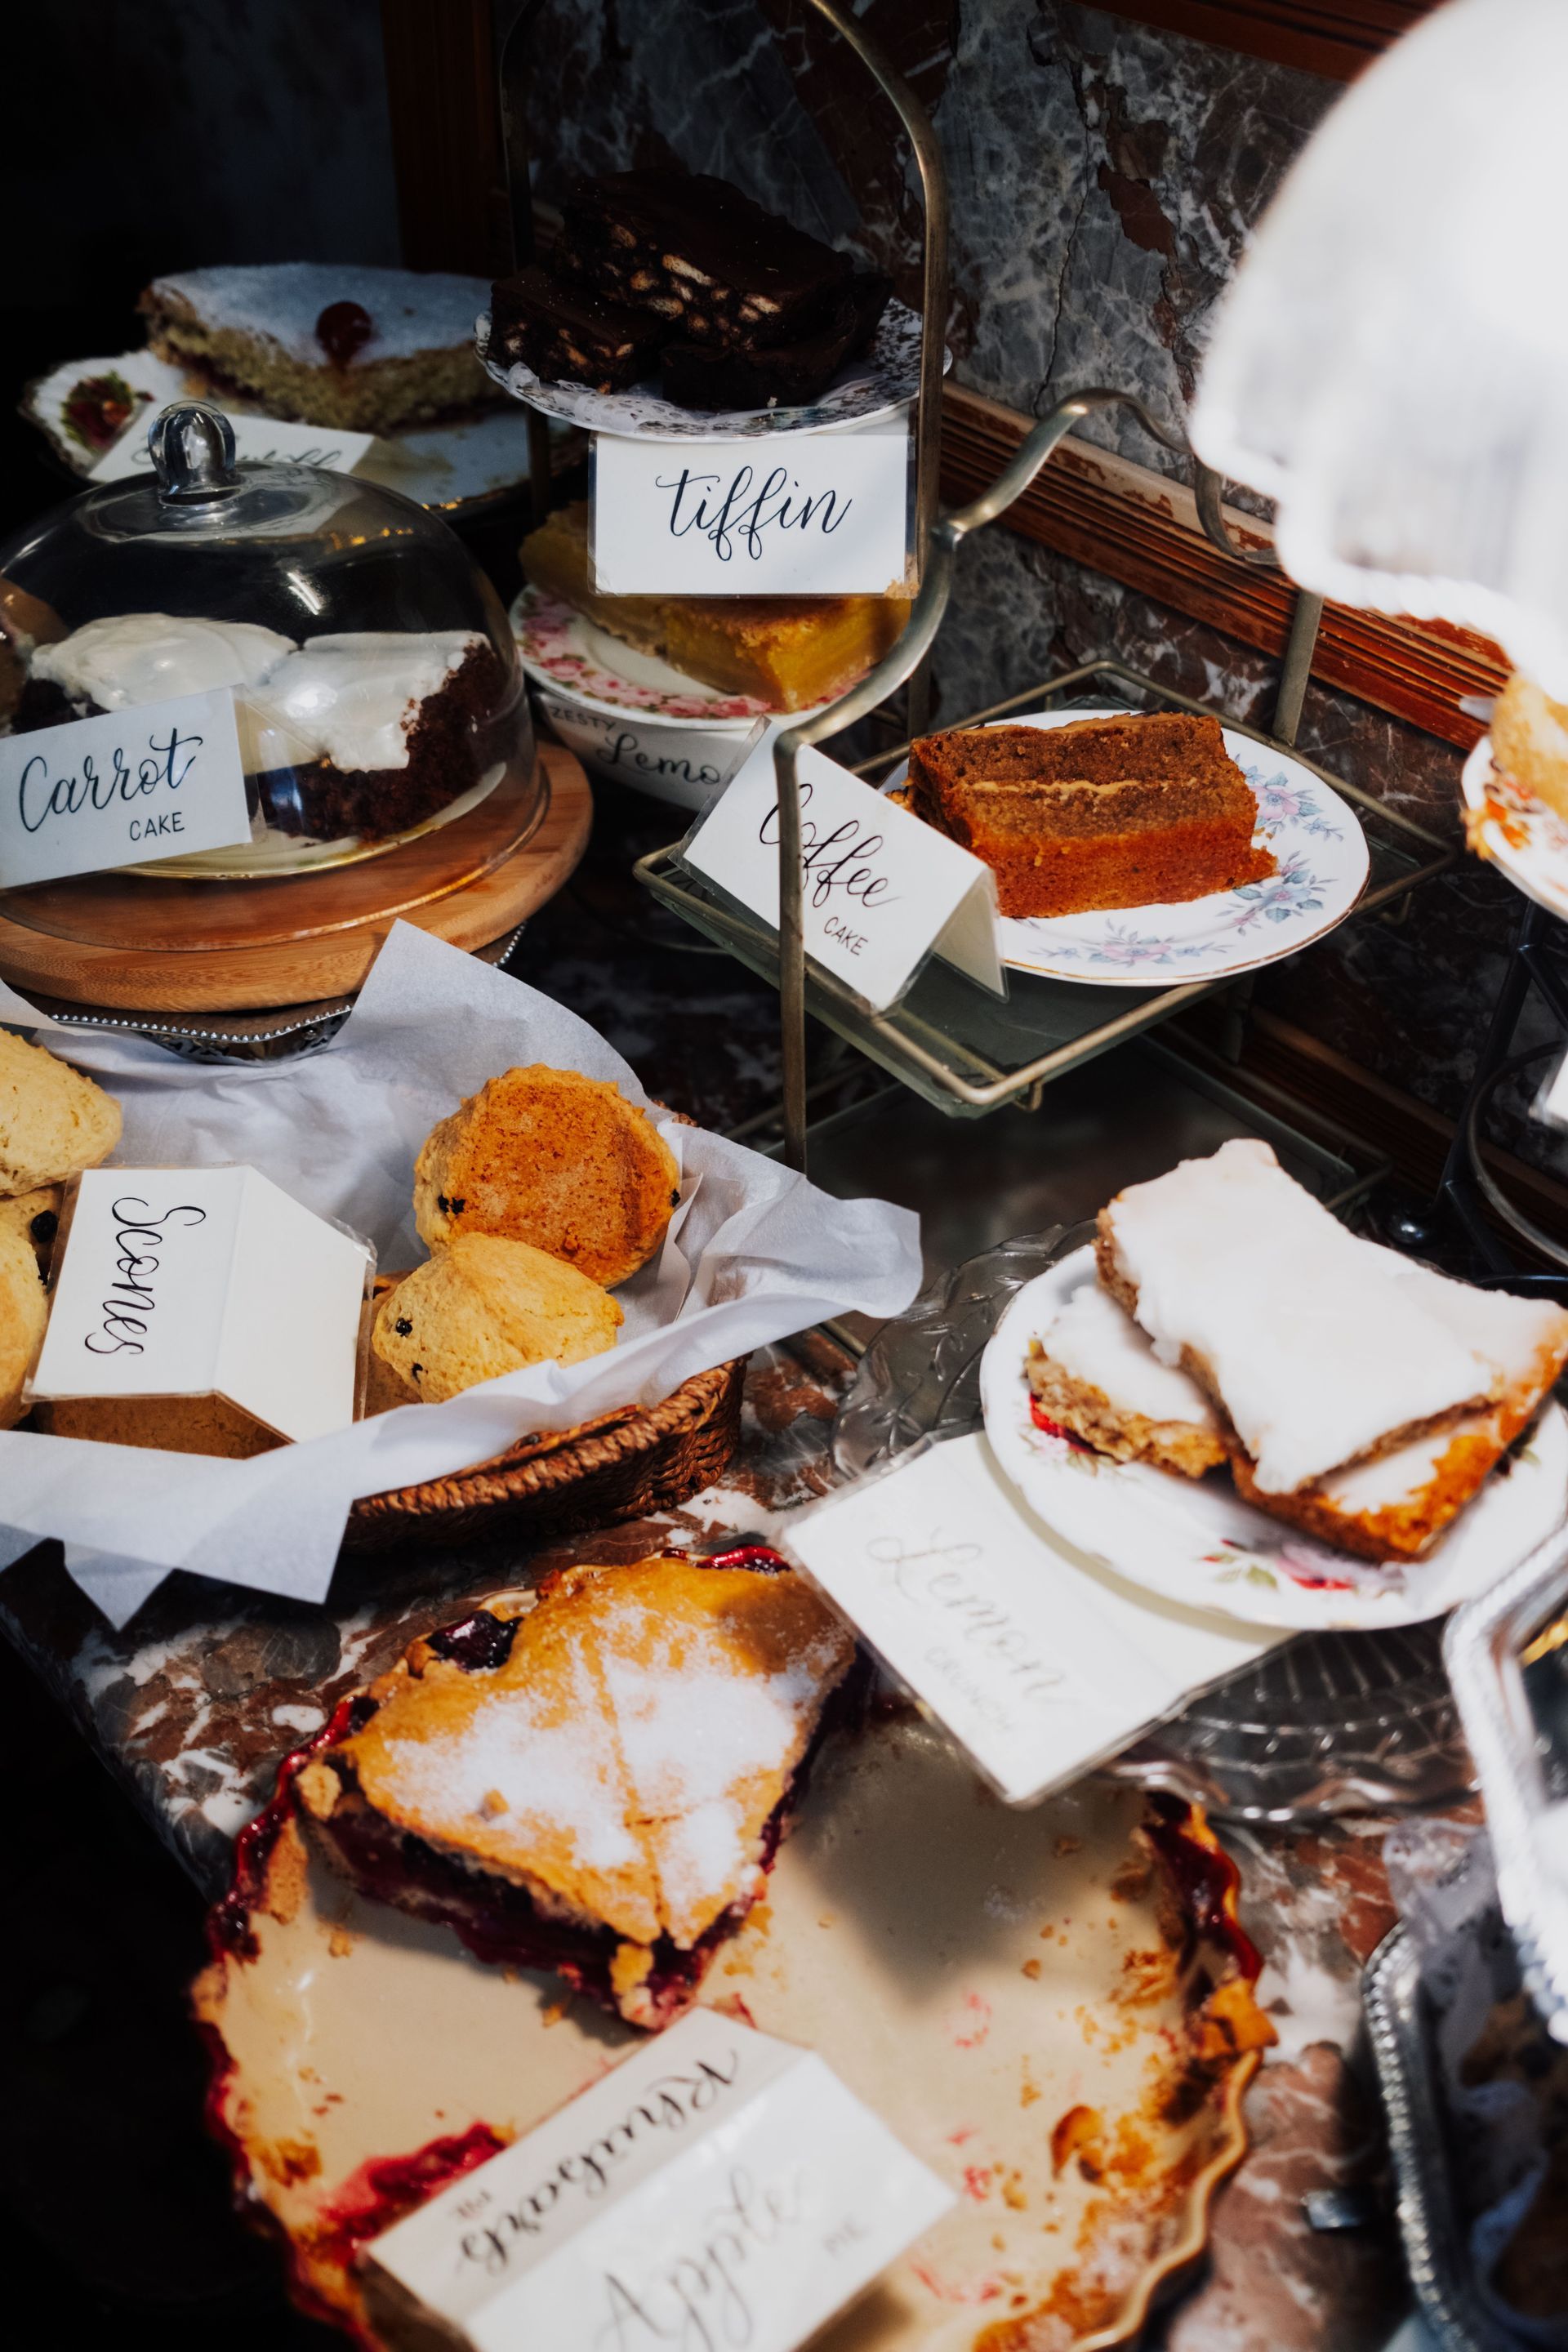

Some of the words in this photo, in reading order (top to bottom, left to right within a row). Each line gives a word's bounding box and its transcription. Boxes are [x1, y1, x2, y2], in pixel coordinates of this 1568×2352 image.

[654, 465, 853, 562] tiffin
[550, 706, 617, 730] ZESTY
[596, 733, 735, 786] Lemo
[19, 727, 203, 833] Carrot
[129, 811, 185, 841] CAKE
[823, 916, 869, 956] CAKE
[84, 1196, 207, 1356] Scones
[865, 1524, 1082, 1708] Lemon
[455, 2048, 740, 2278] Rhubarb
